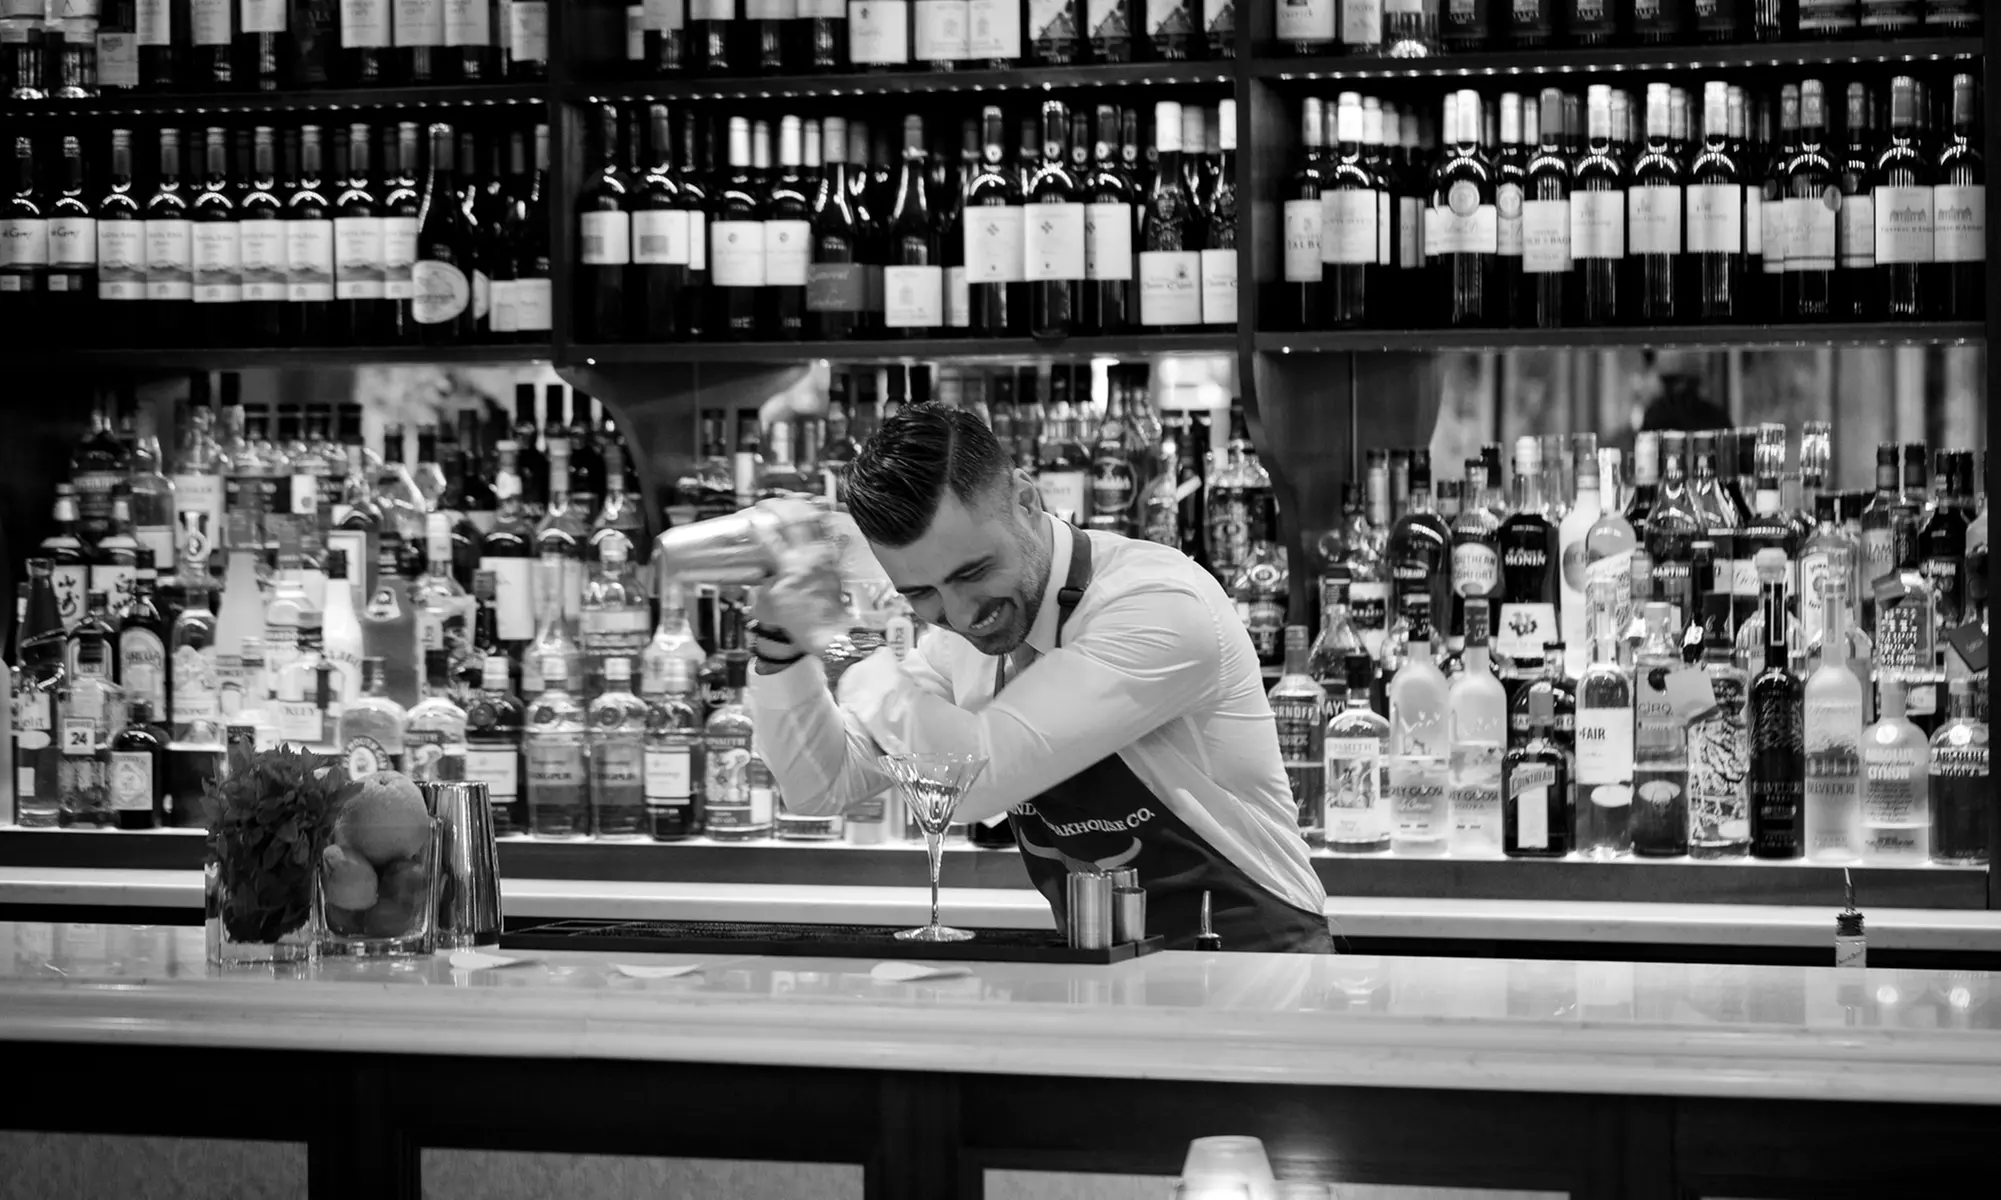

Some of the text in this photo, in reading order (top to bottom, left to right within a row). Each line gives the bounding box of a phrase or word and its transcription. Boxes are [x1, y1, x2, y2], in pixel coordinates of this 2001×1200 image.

[1505, 554, 1546, 566] MONIN
[1652, 566, 1689, 578] MARTINI
[1273, 705, 1315, 720] RNOFF
[71, 731, 89, 746] 24
[1582, 727, 1606, 741] FAIR
[1125, 808, 1154, 828] CO.
